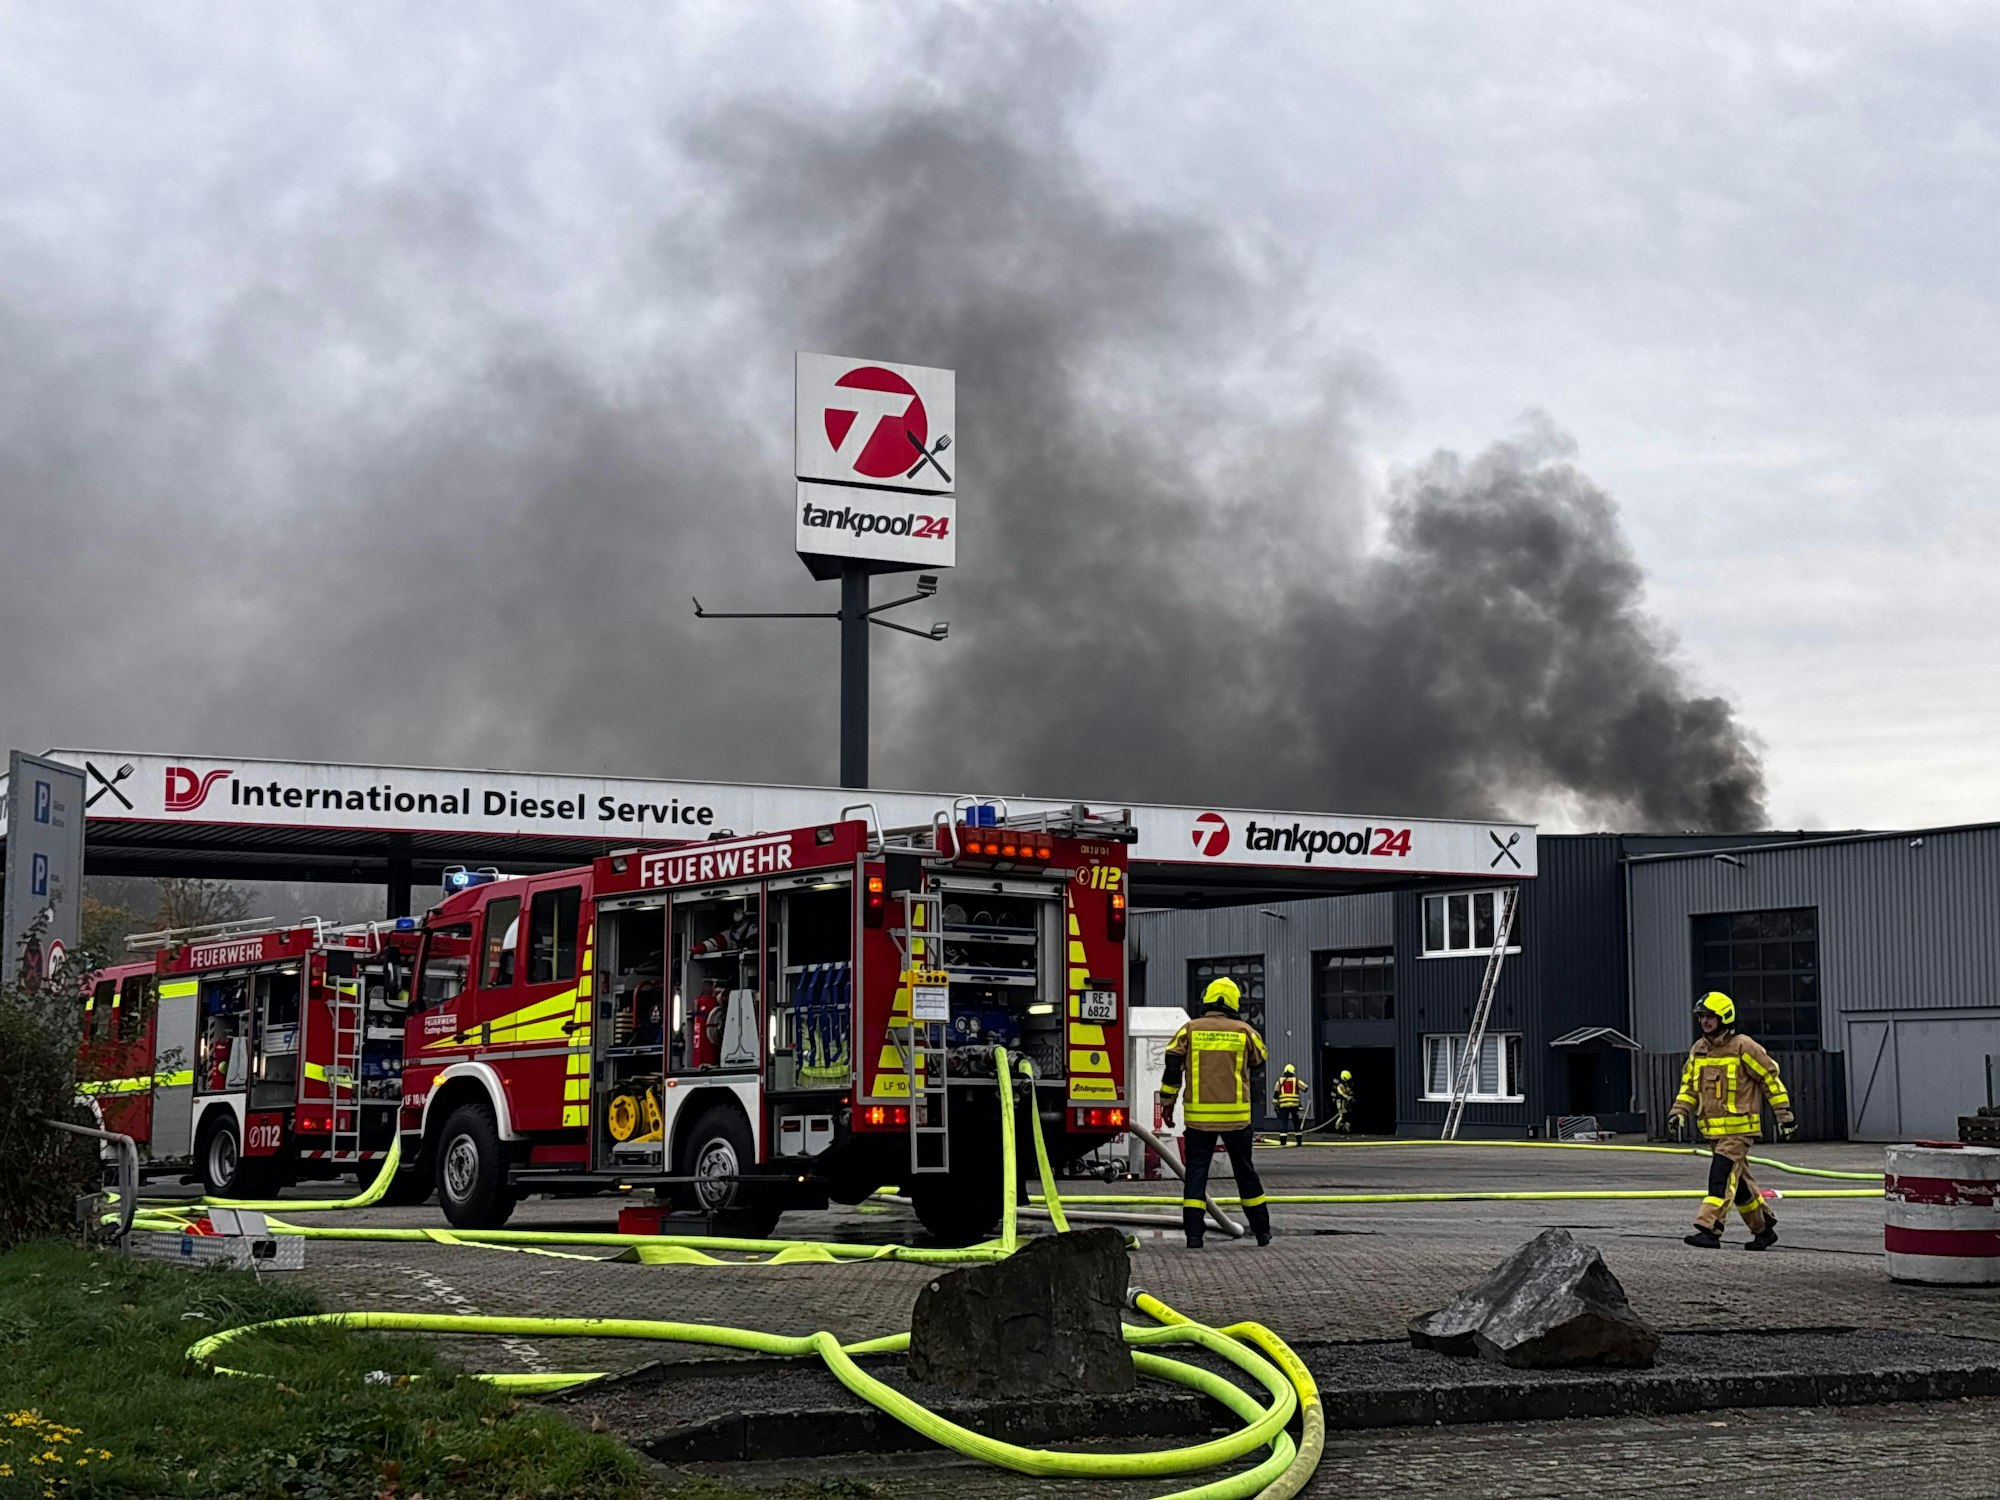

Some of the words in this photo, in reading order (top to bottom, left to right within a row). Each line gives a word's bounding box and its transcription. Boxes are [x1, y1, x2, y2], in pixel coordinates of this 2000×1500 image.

[803, 502, 950, 540] tankpool24
[38, 784, 49, 819] P
[231, 779, 470, 815] International
[483, 790, 585, 820] Diesel
[598, 796, 714, 825] Service
[1246, 821, 1412, 863] tankpool24
[35, 856, 46, 892] P
[640, 834, 793, 888] FEUERWEHR
[1090, 865, 1122, 890] 112
[190, 937, 263, 968] FEUERWEHR
[1087, 1006, 1110, 1018] 6822
[1092, 992, 1105, 1004] RE
[883, 1081, 895, 1091] LF
[260, 1125, 281, 1148] 112
